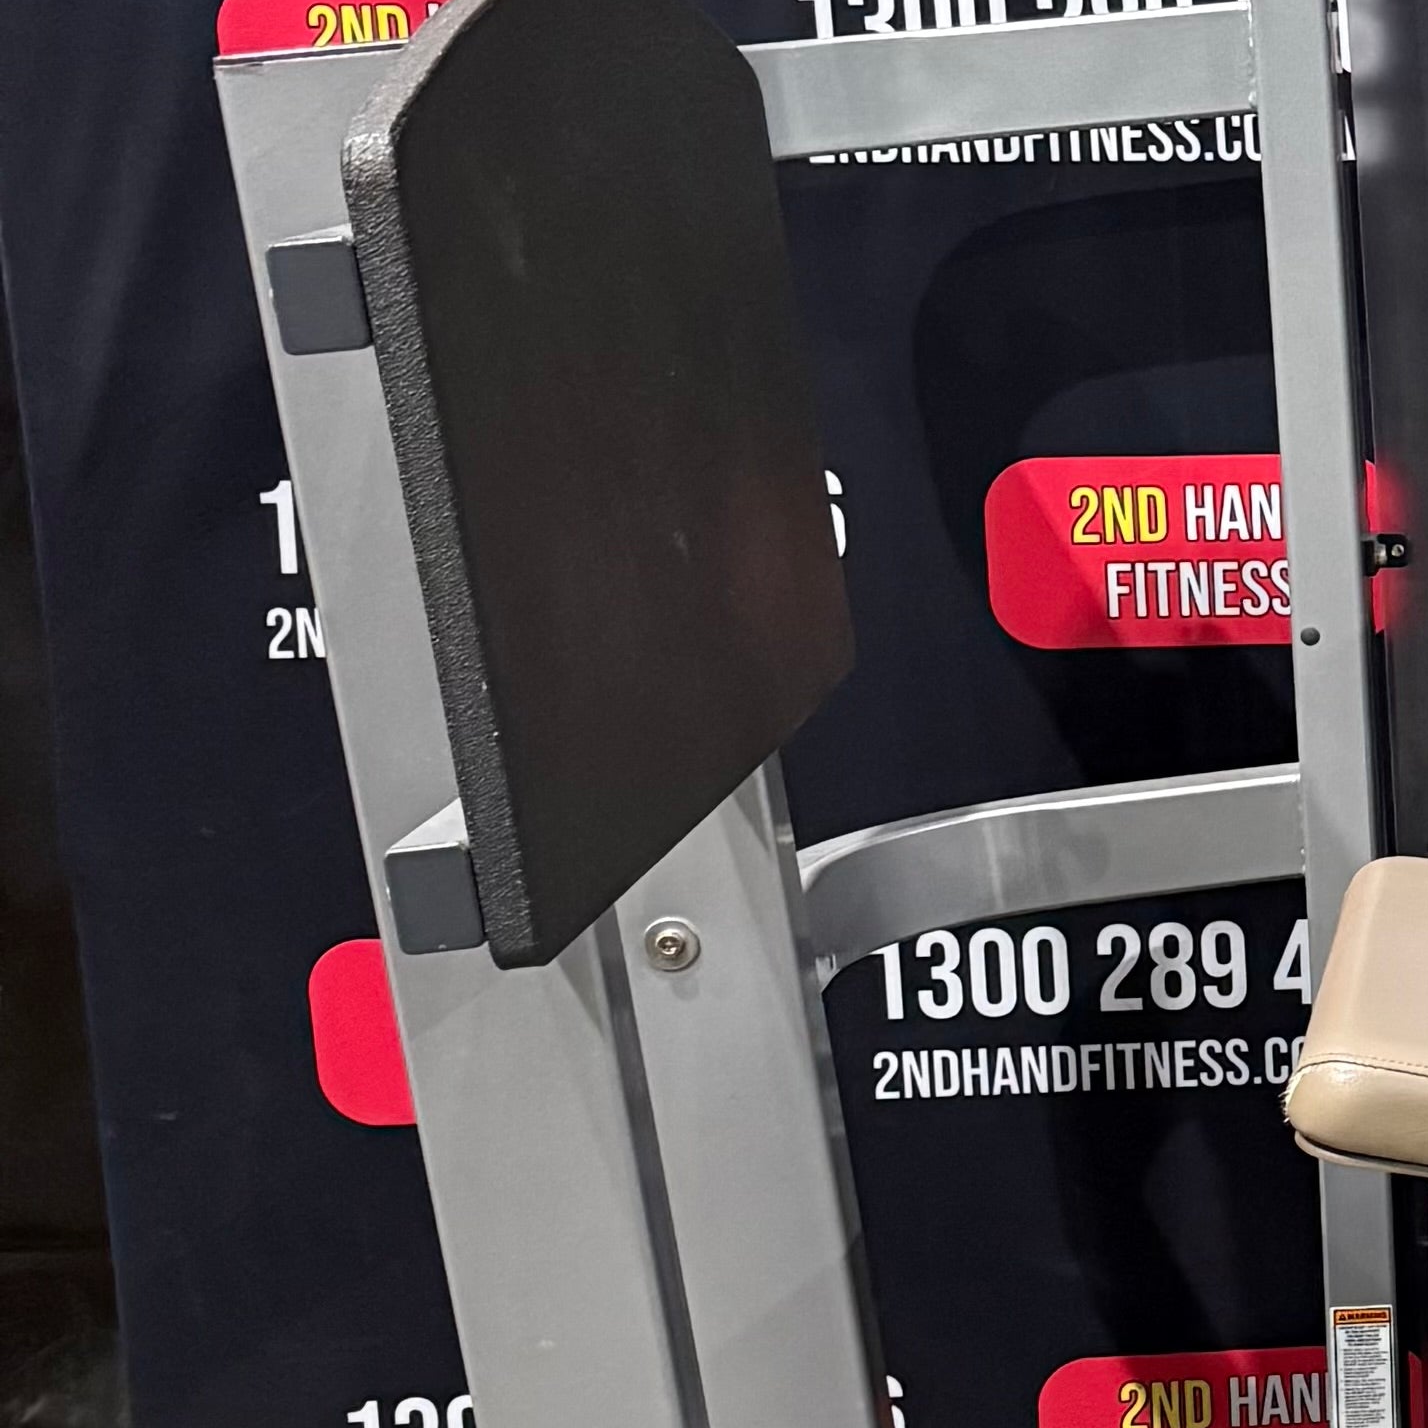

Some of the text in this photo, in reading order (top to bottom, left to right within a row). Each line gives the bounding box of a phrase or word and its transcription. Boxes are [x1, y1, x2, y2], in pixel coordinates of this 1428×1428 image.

[1071, 485, 1281, 542] 2ND HAN
[869, 927, 1069, 1019] 1300
[1097, 921, 1247, 1011] 289
[1230, 1373, 1331, 1427] HAN
